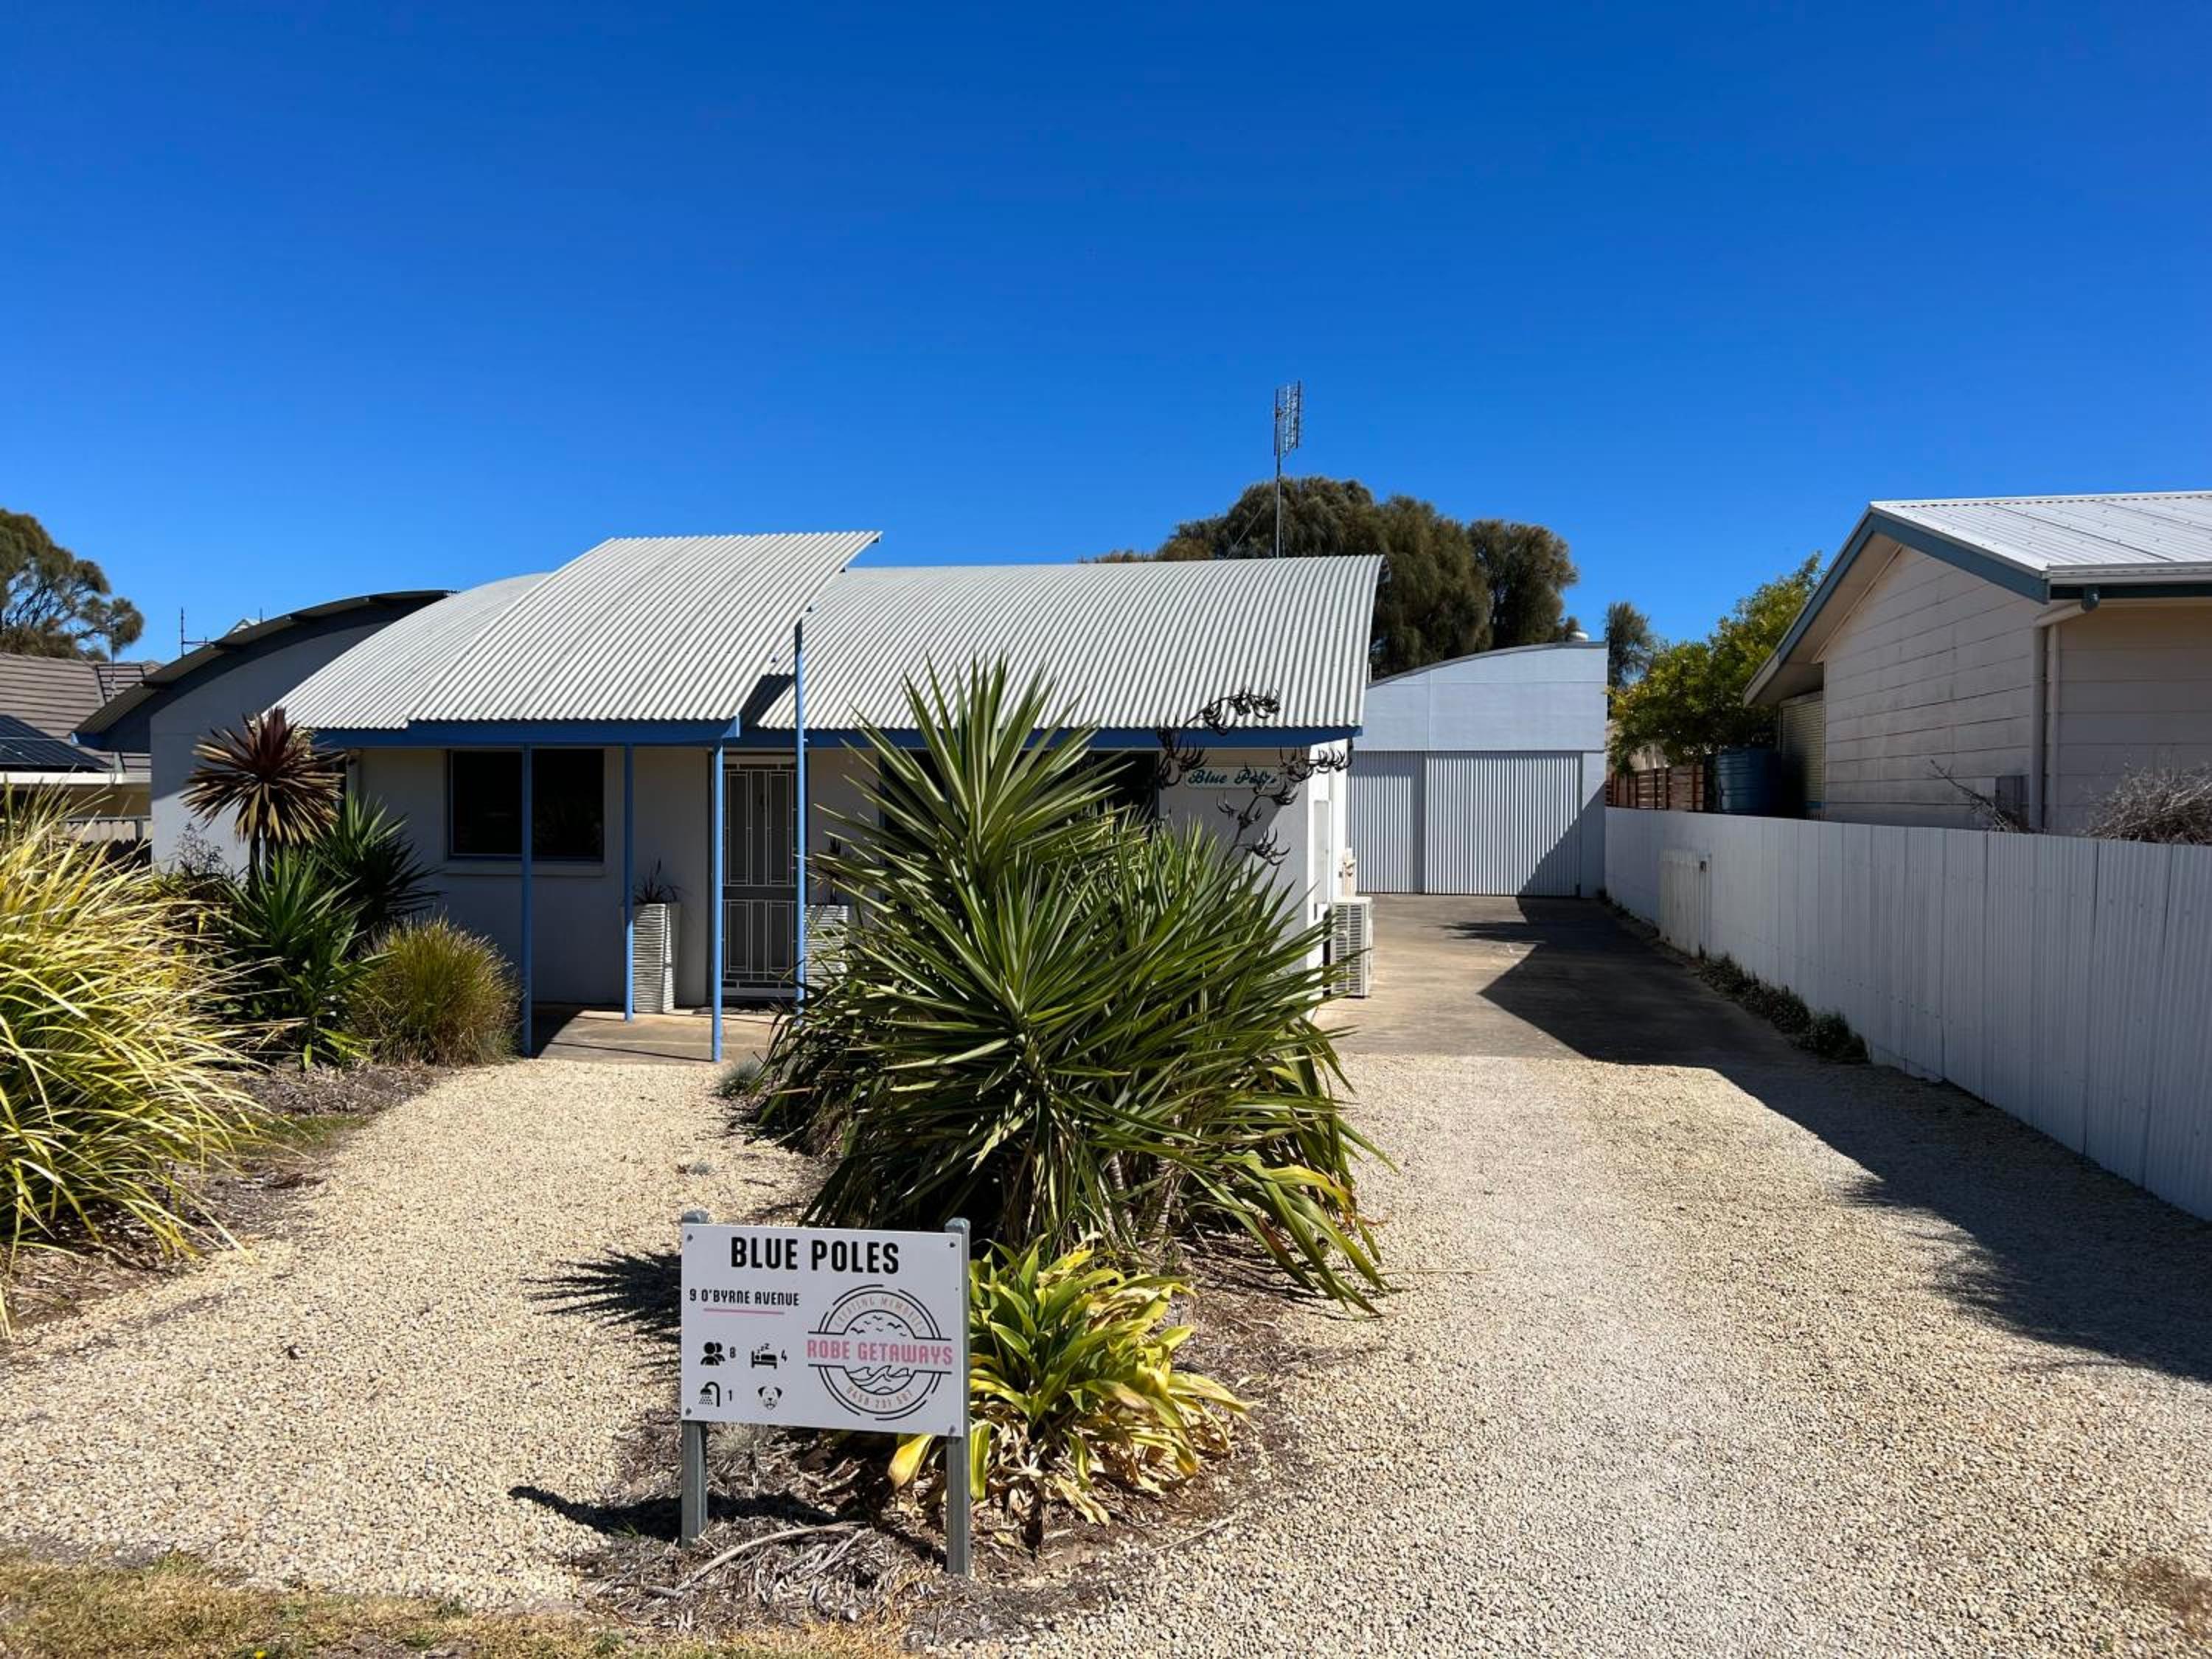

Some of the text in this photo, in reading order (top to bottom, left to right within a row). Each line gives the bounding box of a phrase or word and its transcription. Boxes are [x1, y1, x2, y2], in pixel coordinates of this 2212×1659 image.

[1188, 769, 1227, 784] Blue
[731, 1237, 899, 1274] BLUE POLES
[689, 1288, 799, 1306] 9 O'BYRNE AVENUE
[729, 1346, 736, 1358] 8
[781, 1349, 787, 1362] 4
[807, 1340, 953, 1365] ROBE GETAWAYS
[728, 1389, 732, 1401] 1
